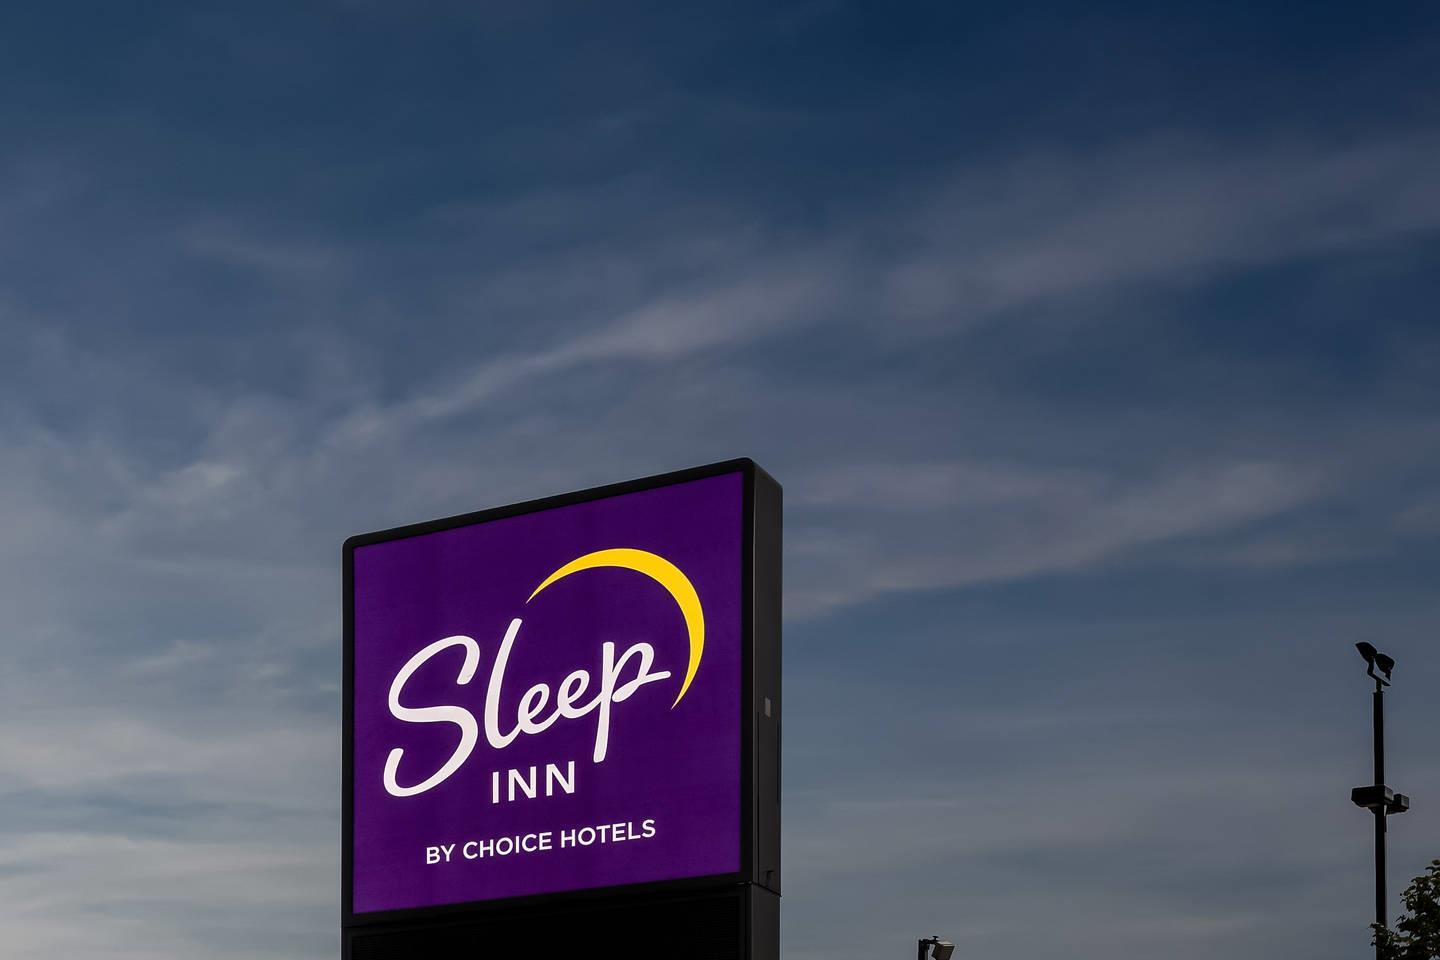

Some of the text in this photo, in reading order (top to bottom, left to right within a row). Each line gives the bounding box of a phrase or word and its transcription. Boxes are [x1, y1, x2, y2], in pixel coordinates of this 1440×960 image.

[383, 617, 672, 797] Sleep
[492, 760, 575, 804] INN
[426, 819, 656, 865] BY CHOICE HOTELS
